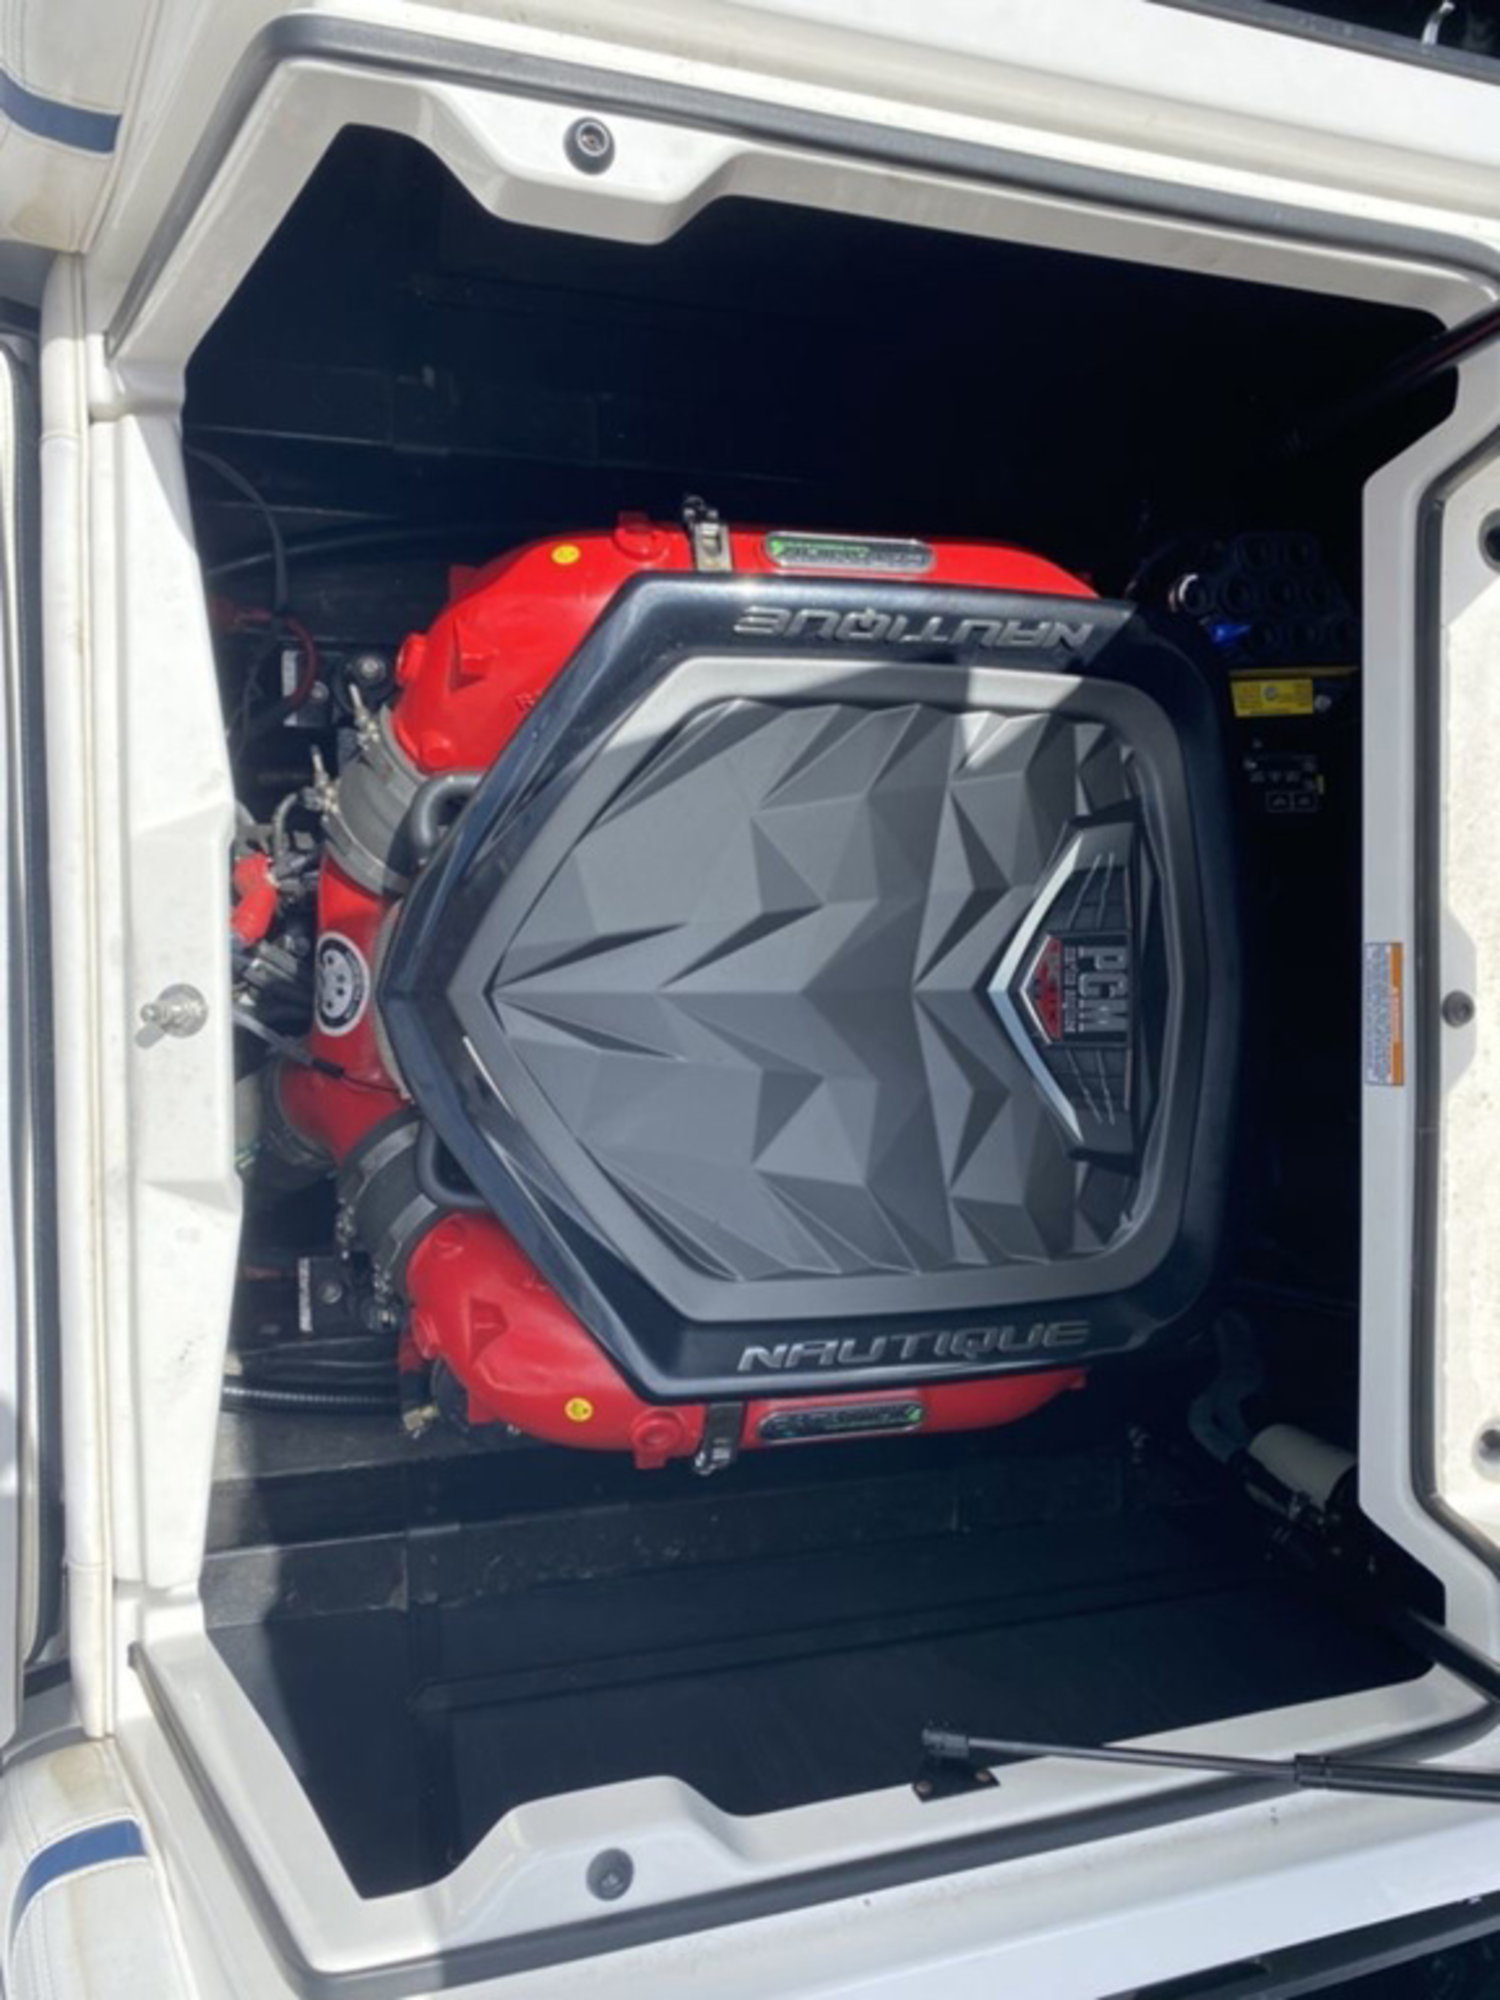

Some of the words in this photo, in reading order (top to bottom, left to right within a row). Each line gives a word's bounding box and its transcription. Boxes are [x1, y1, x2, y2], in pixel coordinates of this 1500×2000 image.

[734, 606, 1094, 649] NAUTIQUE
[1078, 946, 1127, 1032] PCM
[737, 1320, 1090, 1371] NAUTIQUE
